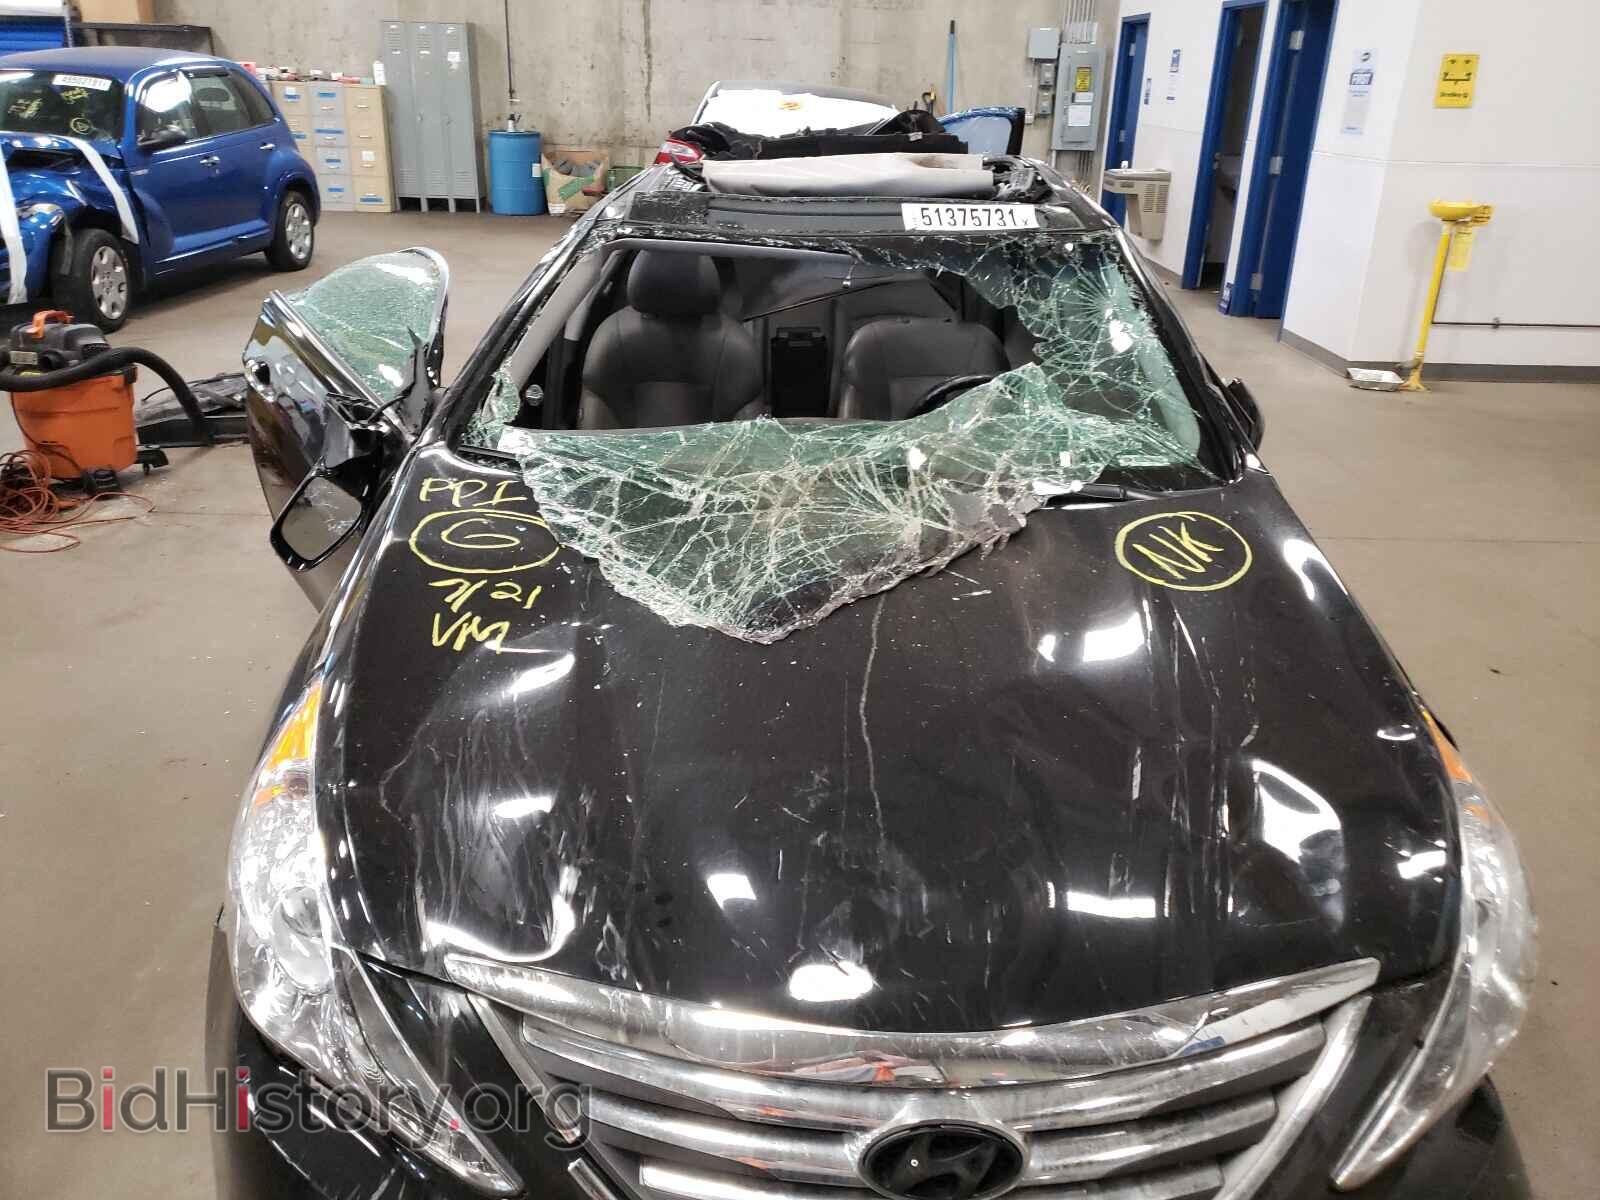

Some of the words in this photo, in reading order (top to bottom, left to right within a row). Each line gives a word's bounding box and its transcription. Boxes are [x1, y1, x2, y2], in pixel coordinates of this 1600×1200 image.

[920, 207, 1017, 226] 51375731
[419, 477, 527, 508] PPI
[1131, 521, 1225, 581] NK
